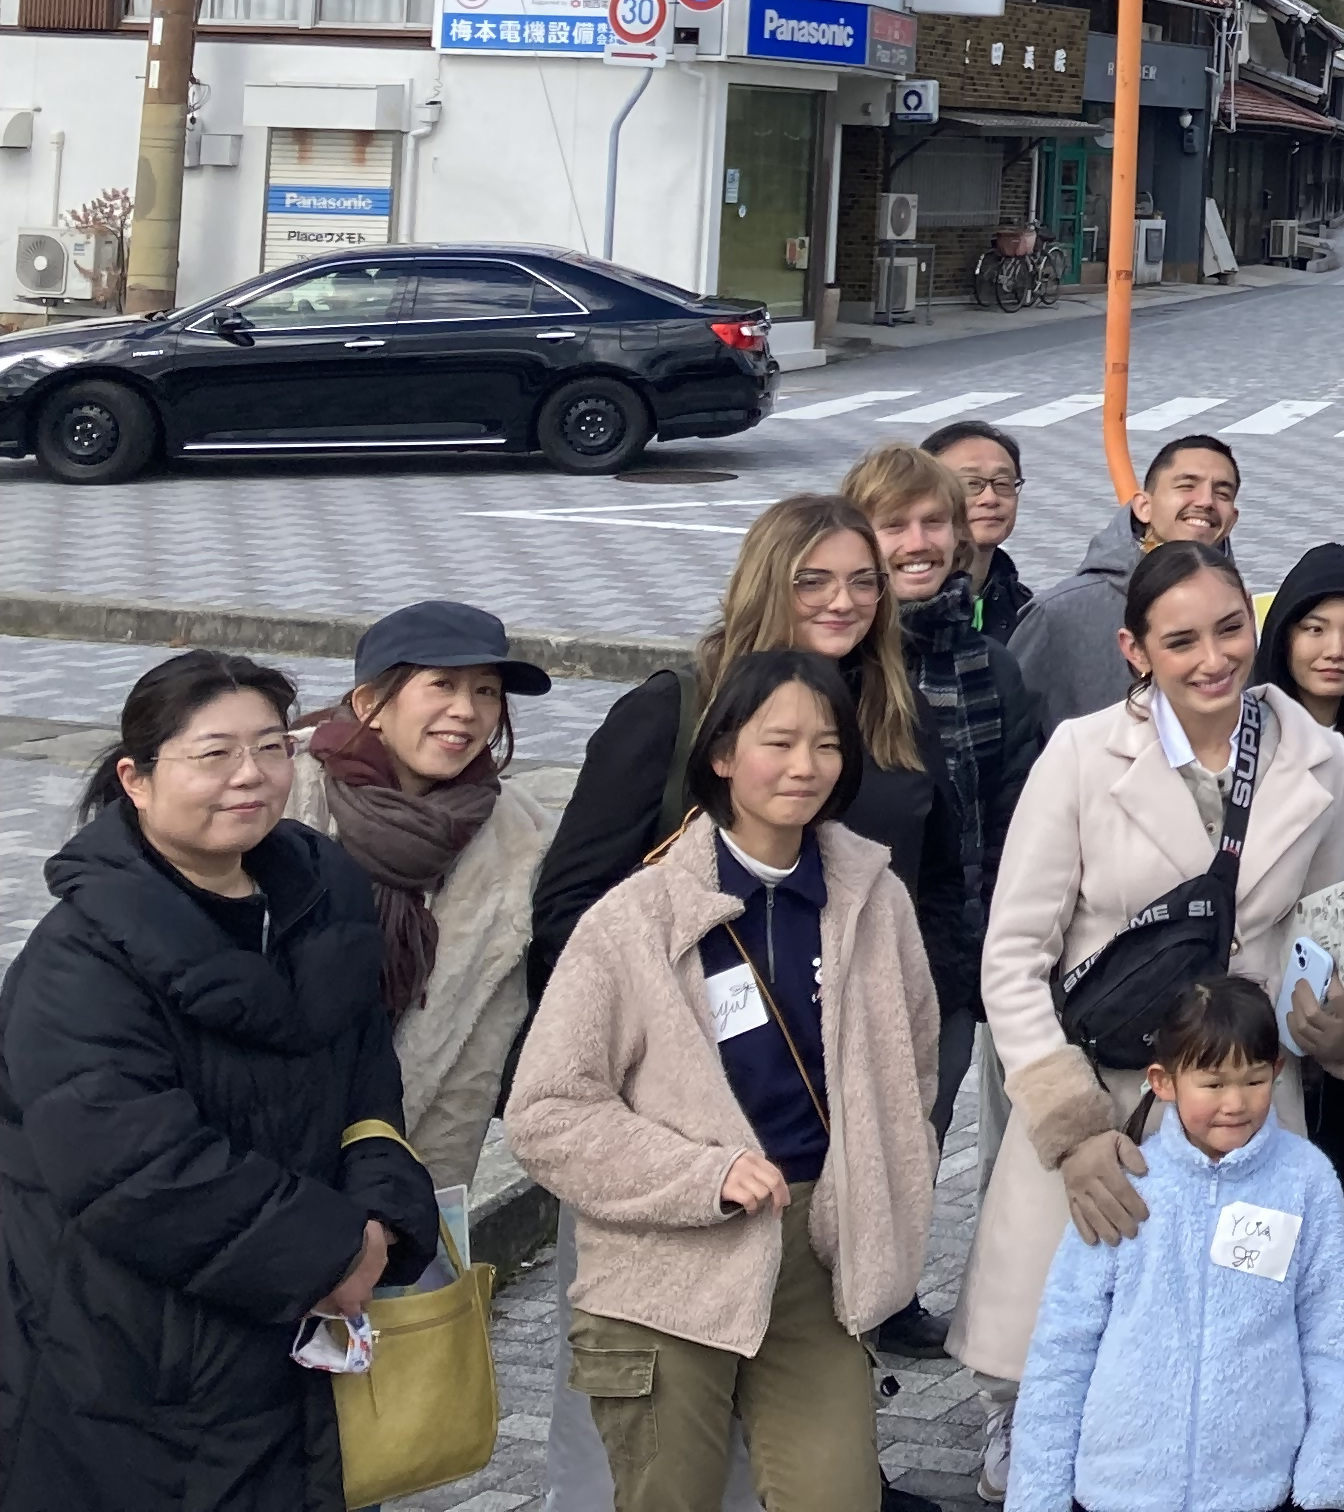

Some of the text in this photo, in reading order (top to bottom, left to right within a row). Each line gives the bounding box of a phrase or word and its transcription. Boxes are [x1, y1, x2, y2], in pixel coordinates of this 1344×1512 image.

[450, 19, 595, 45] 梅本電機設備
[763, 8, 855, 48] Panasonic
[285, 192, 373, 210] Panasonic
